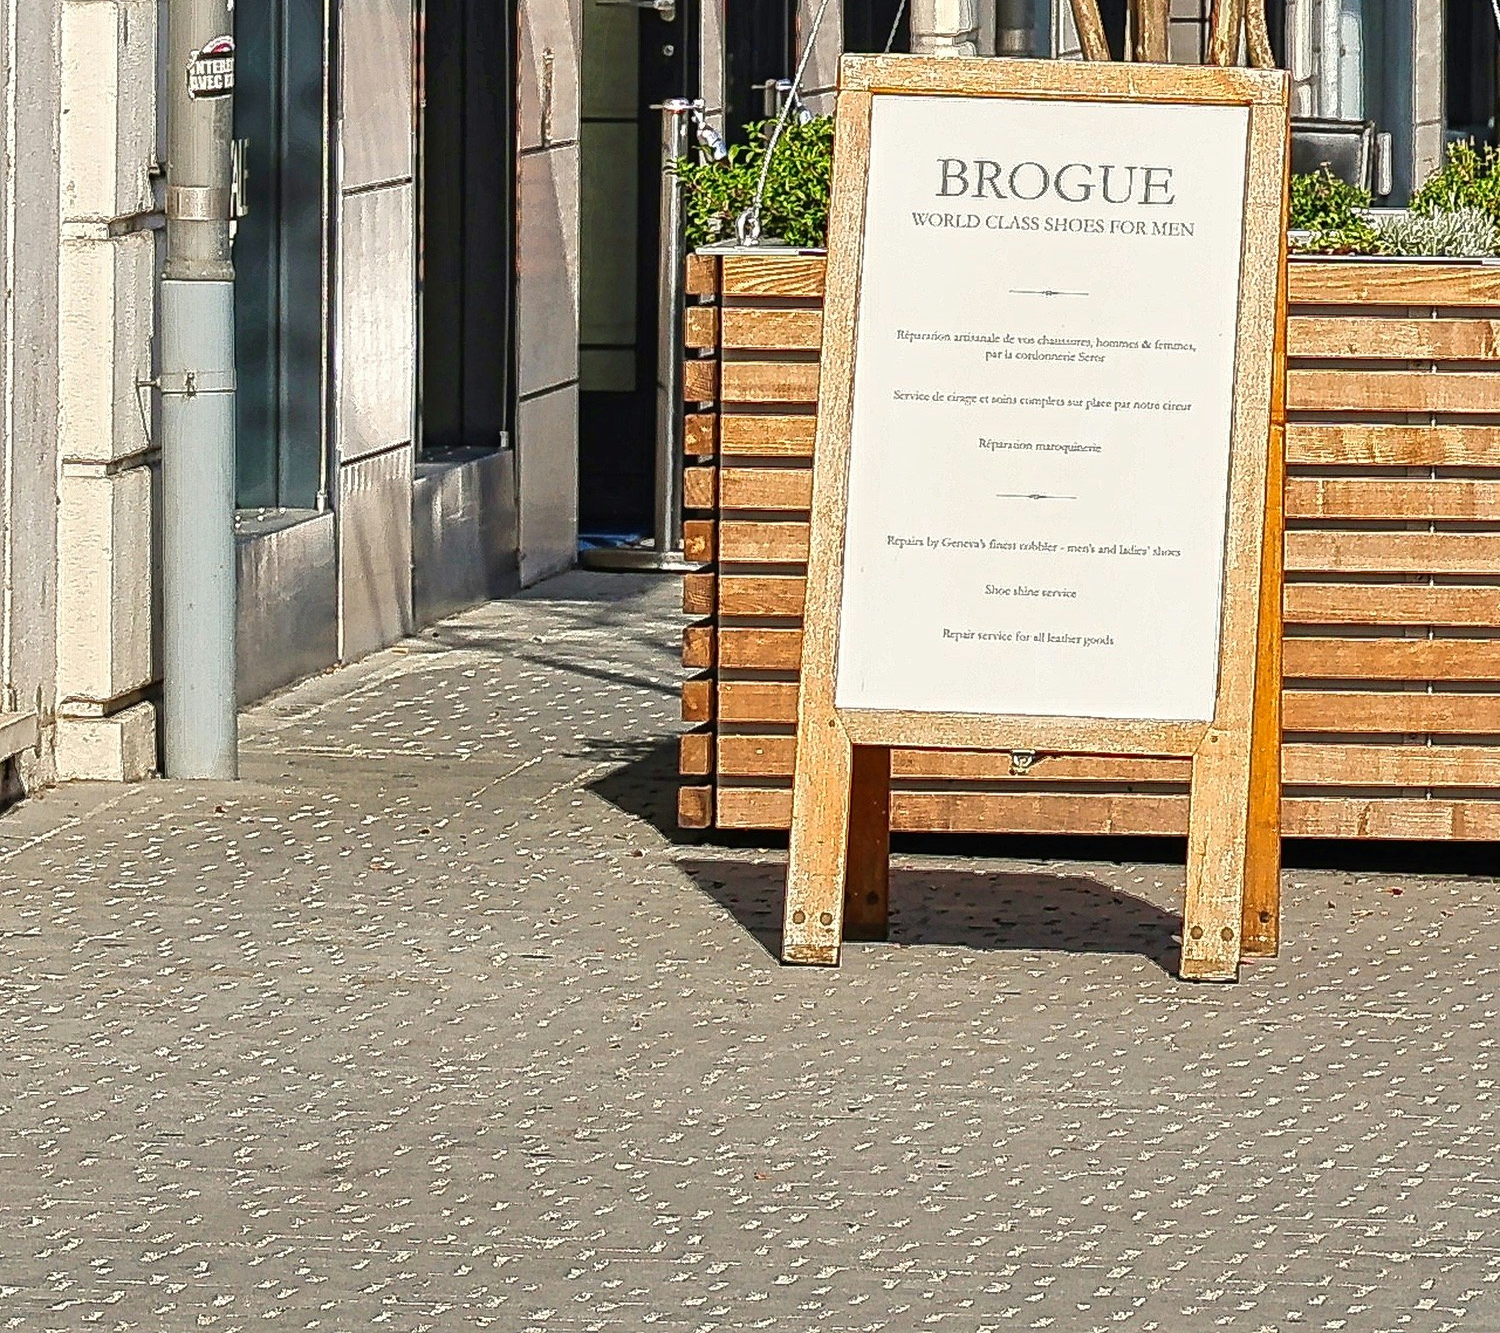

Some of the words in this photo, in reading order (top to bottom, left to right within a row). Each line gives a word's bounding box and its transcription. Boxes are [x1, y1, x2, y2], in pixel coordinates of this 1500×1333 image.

[935, 158, 1176, 205] BROGUE
[912, 213, 980, 228] WORLD
[986, 216, 1039, 230] CLASS
[1045, 217, 1104, 233] SHOES
[1110, 221, 1145, 235] FOR
[1152, 222, 1194, 236] MEN
[954, 332, 1000, 343] artisanale
[1003, 333, 1015, 344] de
[985, 351, 1003, 362] par
[1004, 348, 1013, 360] la
[893, 389, 930, 402] Service
[931, 391, 945, 402] de
[1085, 398, 1112, 411] place
[1114, 401, 1131, 412] par
[978, 438, 1033, 452] Réparation
[887, 535, 925, 549] Repairs
[926, 536, 940, 550] by
[941, 537, 987, 549] Geneva's
[989, 538, 1016, 551] finest
[1067, 543, 1096, 554] men's
[1098, 544, 1117, 555] and
[984, 584, 1011, 596] Shoe
[1013, 585, 1040, 597] shine
[1041, 589, 1077, 599] service
[942, 628, 976, 642] Repair
[977, 631, 1013, 642] service
[1015, 630, 1030, 642] for
[1033, 632, 1045, 643] all
[1046, 632, 1082, 644] leather
